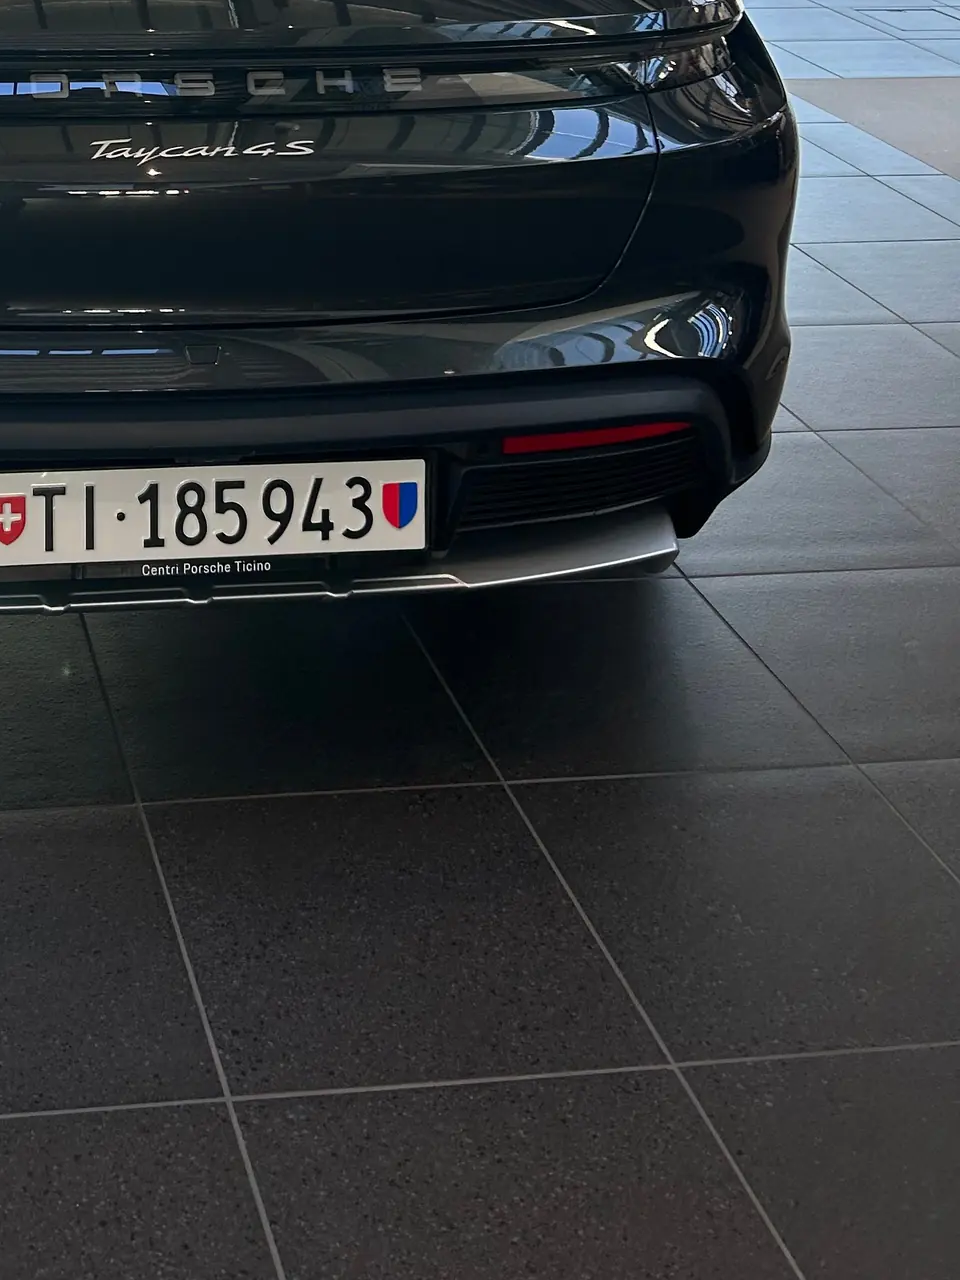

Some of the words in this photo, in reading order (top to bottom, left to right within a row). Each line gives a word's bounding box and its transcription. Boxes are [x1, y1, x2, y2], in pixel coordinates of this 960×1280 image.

[90, 138, 239, 166] Taycan
[242, 140, 315, 157] 4S
[142, 563, 179, 577] Centri
[183, 562, 231, 575] Porsche
[234, 560, 271, 573] Ticino
